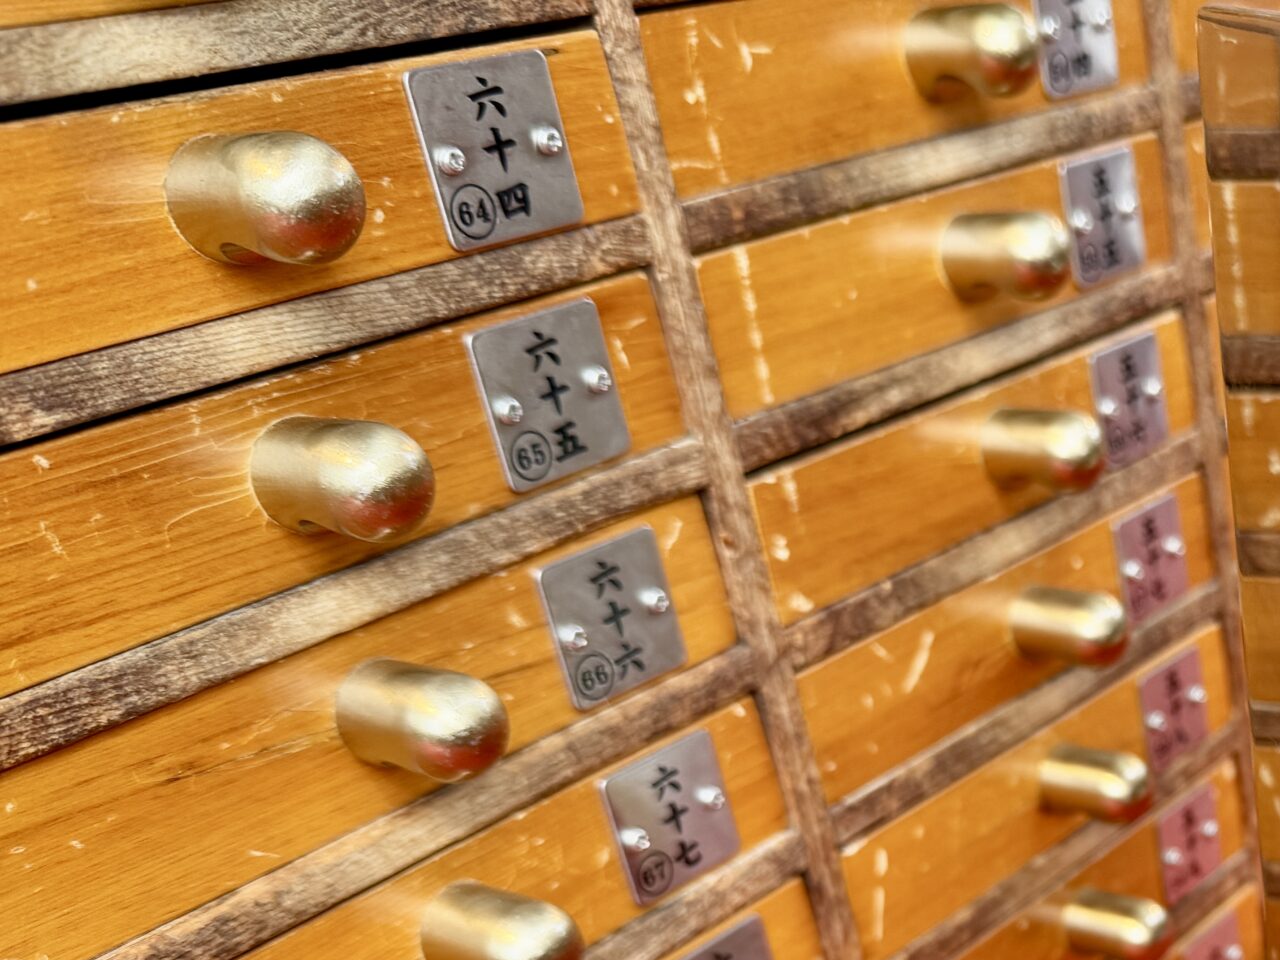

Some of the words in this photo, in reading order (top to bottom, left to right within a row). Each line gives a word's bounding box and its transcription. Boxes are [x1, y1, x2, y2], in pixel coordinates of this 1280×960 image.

[466, 75, 532, 218] 六十四
[455, 193, 494, 230] 64
[524, 330, 588, 462] 六十五
[514, 438, 549, 474] 65
[590, 560, 647, 680] 六十六
[578, 662, 611, 693] 66
[652, 764, 704, 869] 六十七
